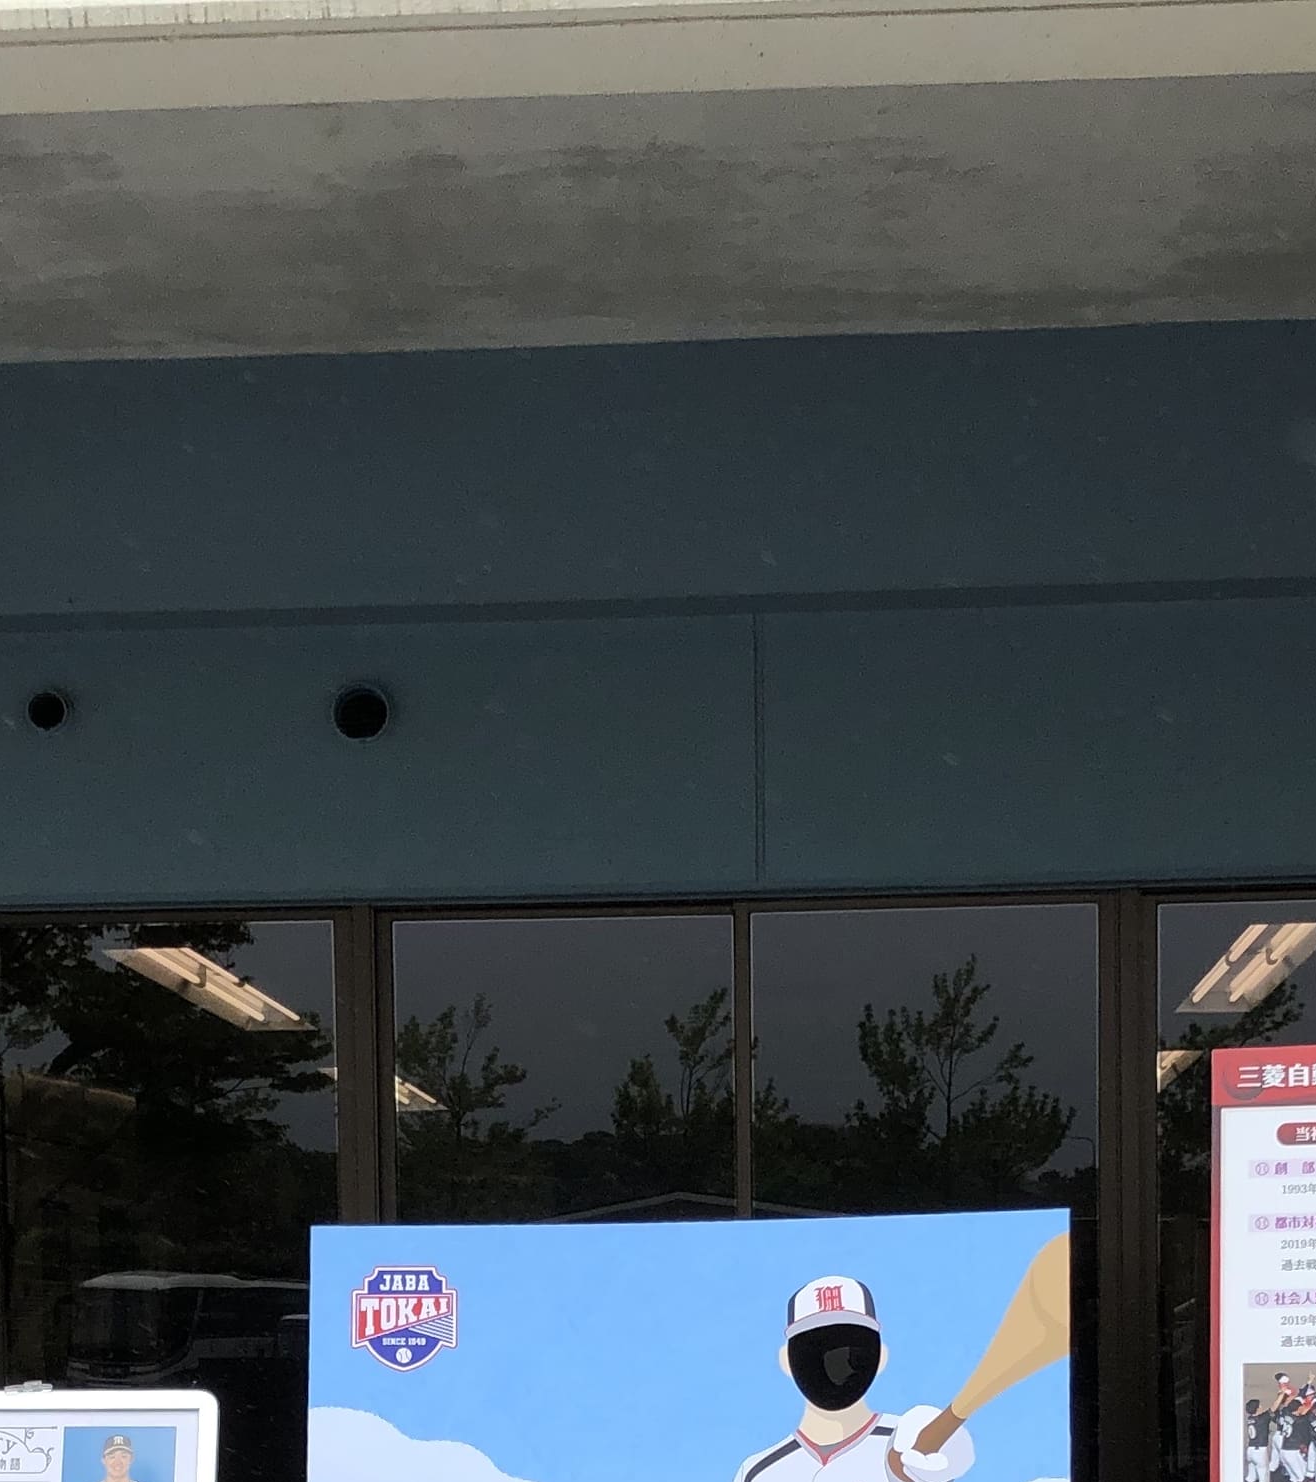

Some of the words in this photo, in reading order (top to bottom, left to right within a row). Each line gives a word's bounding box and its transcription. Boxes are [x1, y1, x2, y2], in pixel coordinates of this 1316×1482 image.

[379, 1274, 430, 1291] JABA
[360, 1297, 449, 1337] TOKAI
[382, 1338, 406, 1346] SINCE
